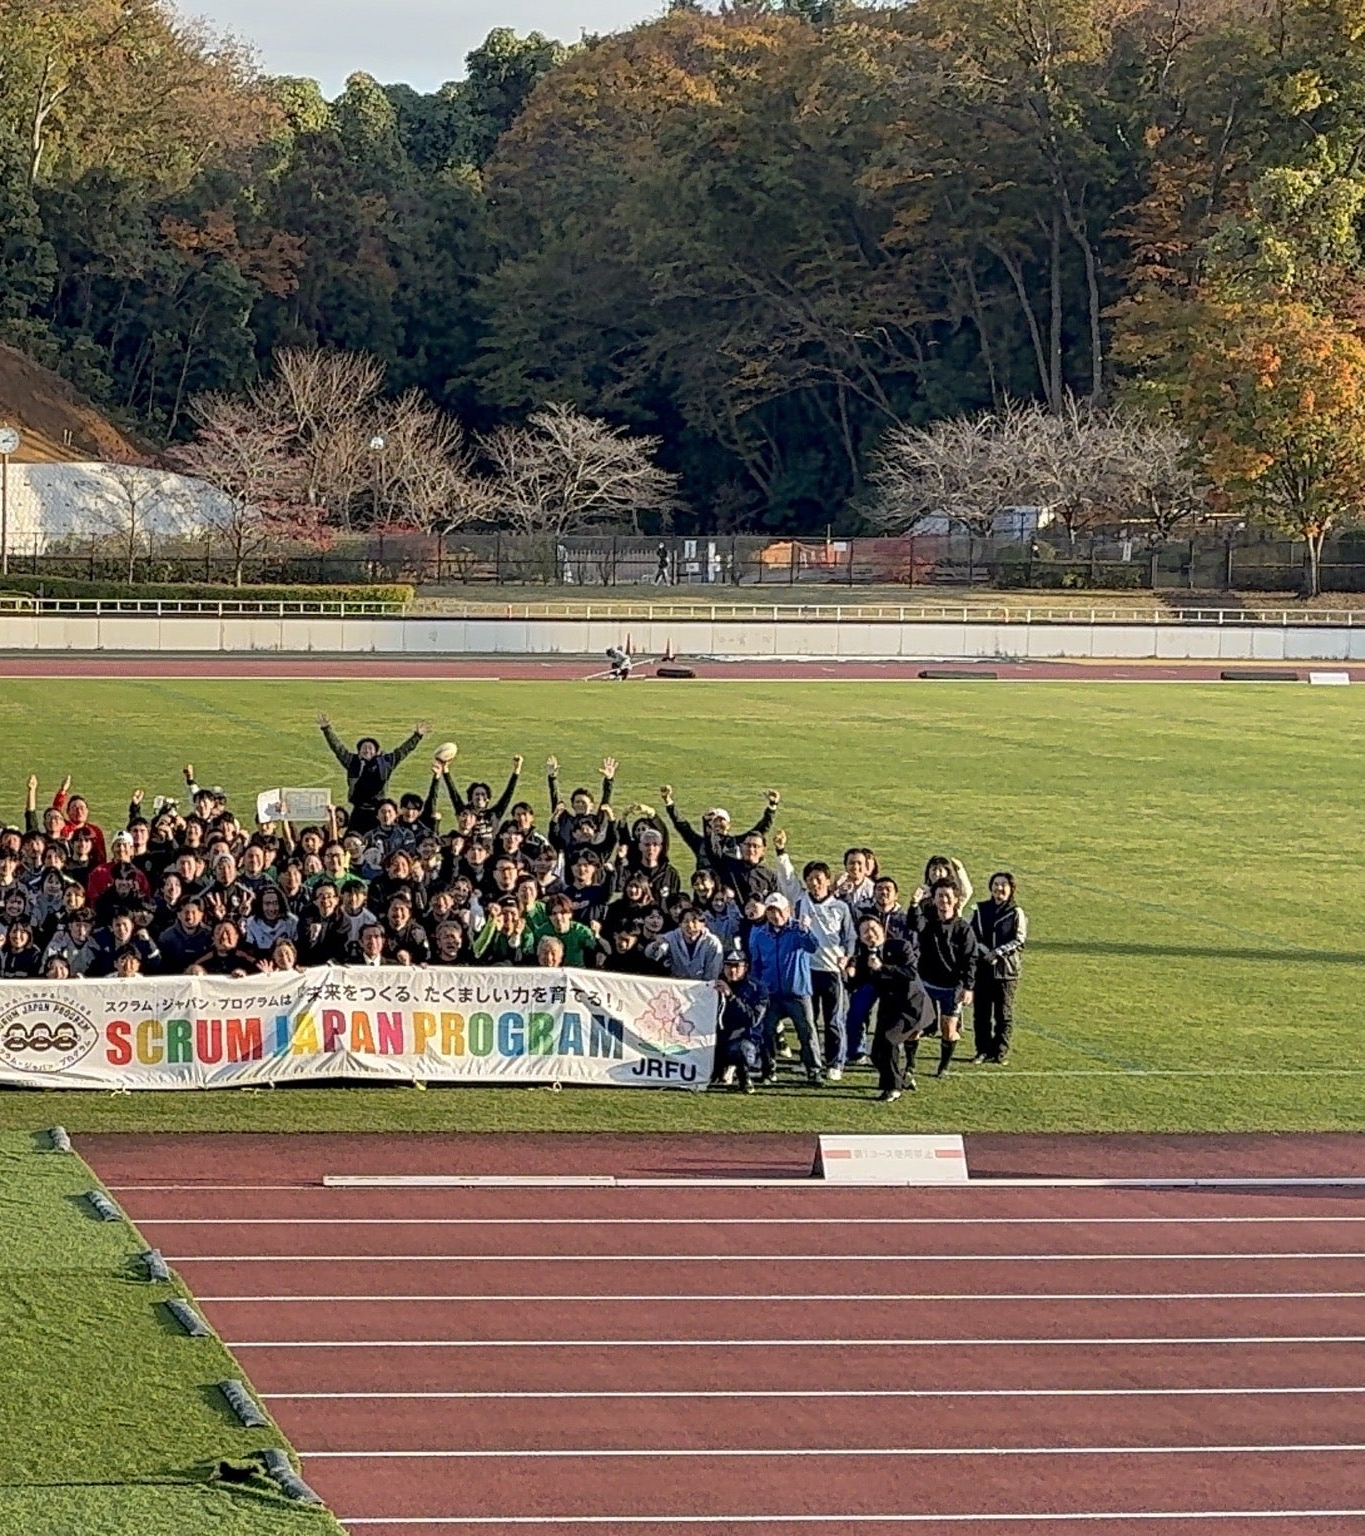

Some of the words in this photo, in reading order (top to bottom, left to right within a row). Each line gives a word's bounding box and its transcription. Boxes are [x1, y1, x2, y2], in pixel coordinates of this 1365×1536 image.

[22, 1003, 50, 1015] JAPAN
[53, 1004, 91, 1033] PROGRAM
[106, 1018, 263, 1066] SCRUM
[272, 1009, 404, 1057] JAPAN
[413, 1011, 624, 1061] PROGRAM
[632, 1058, 697, 1082] JRFU
